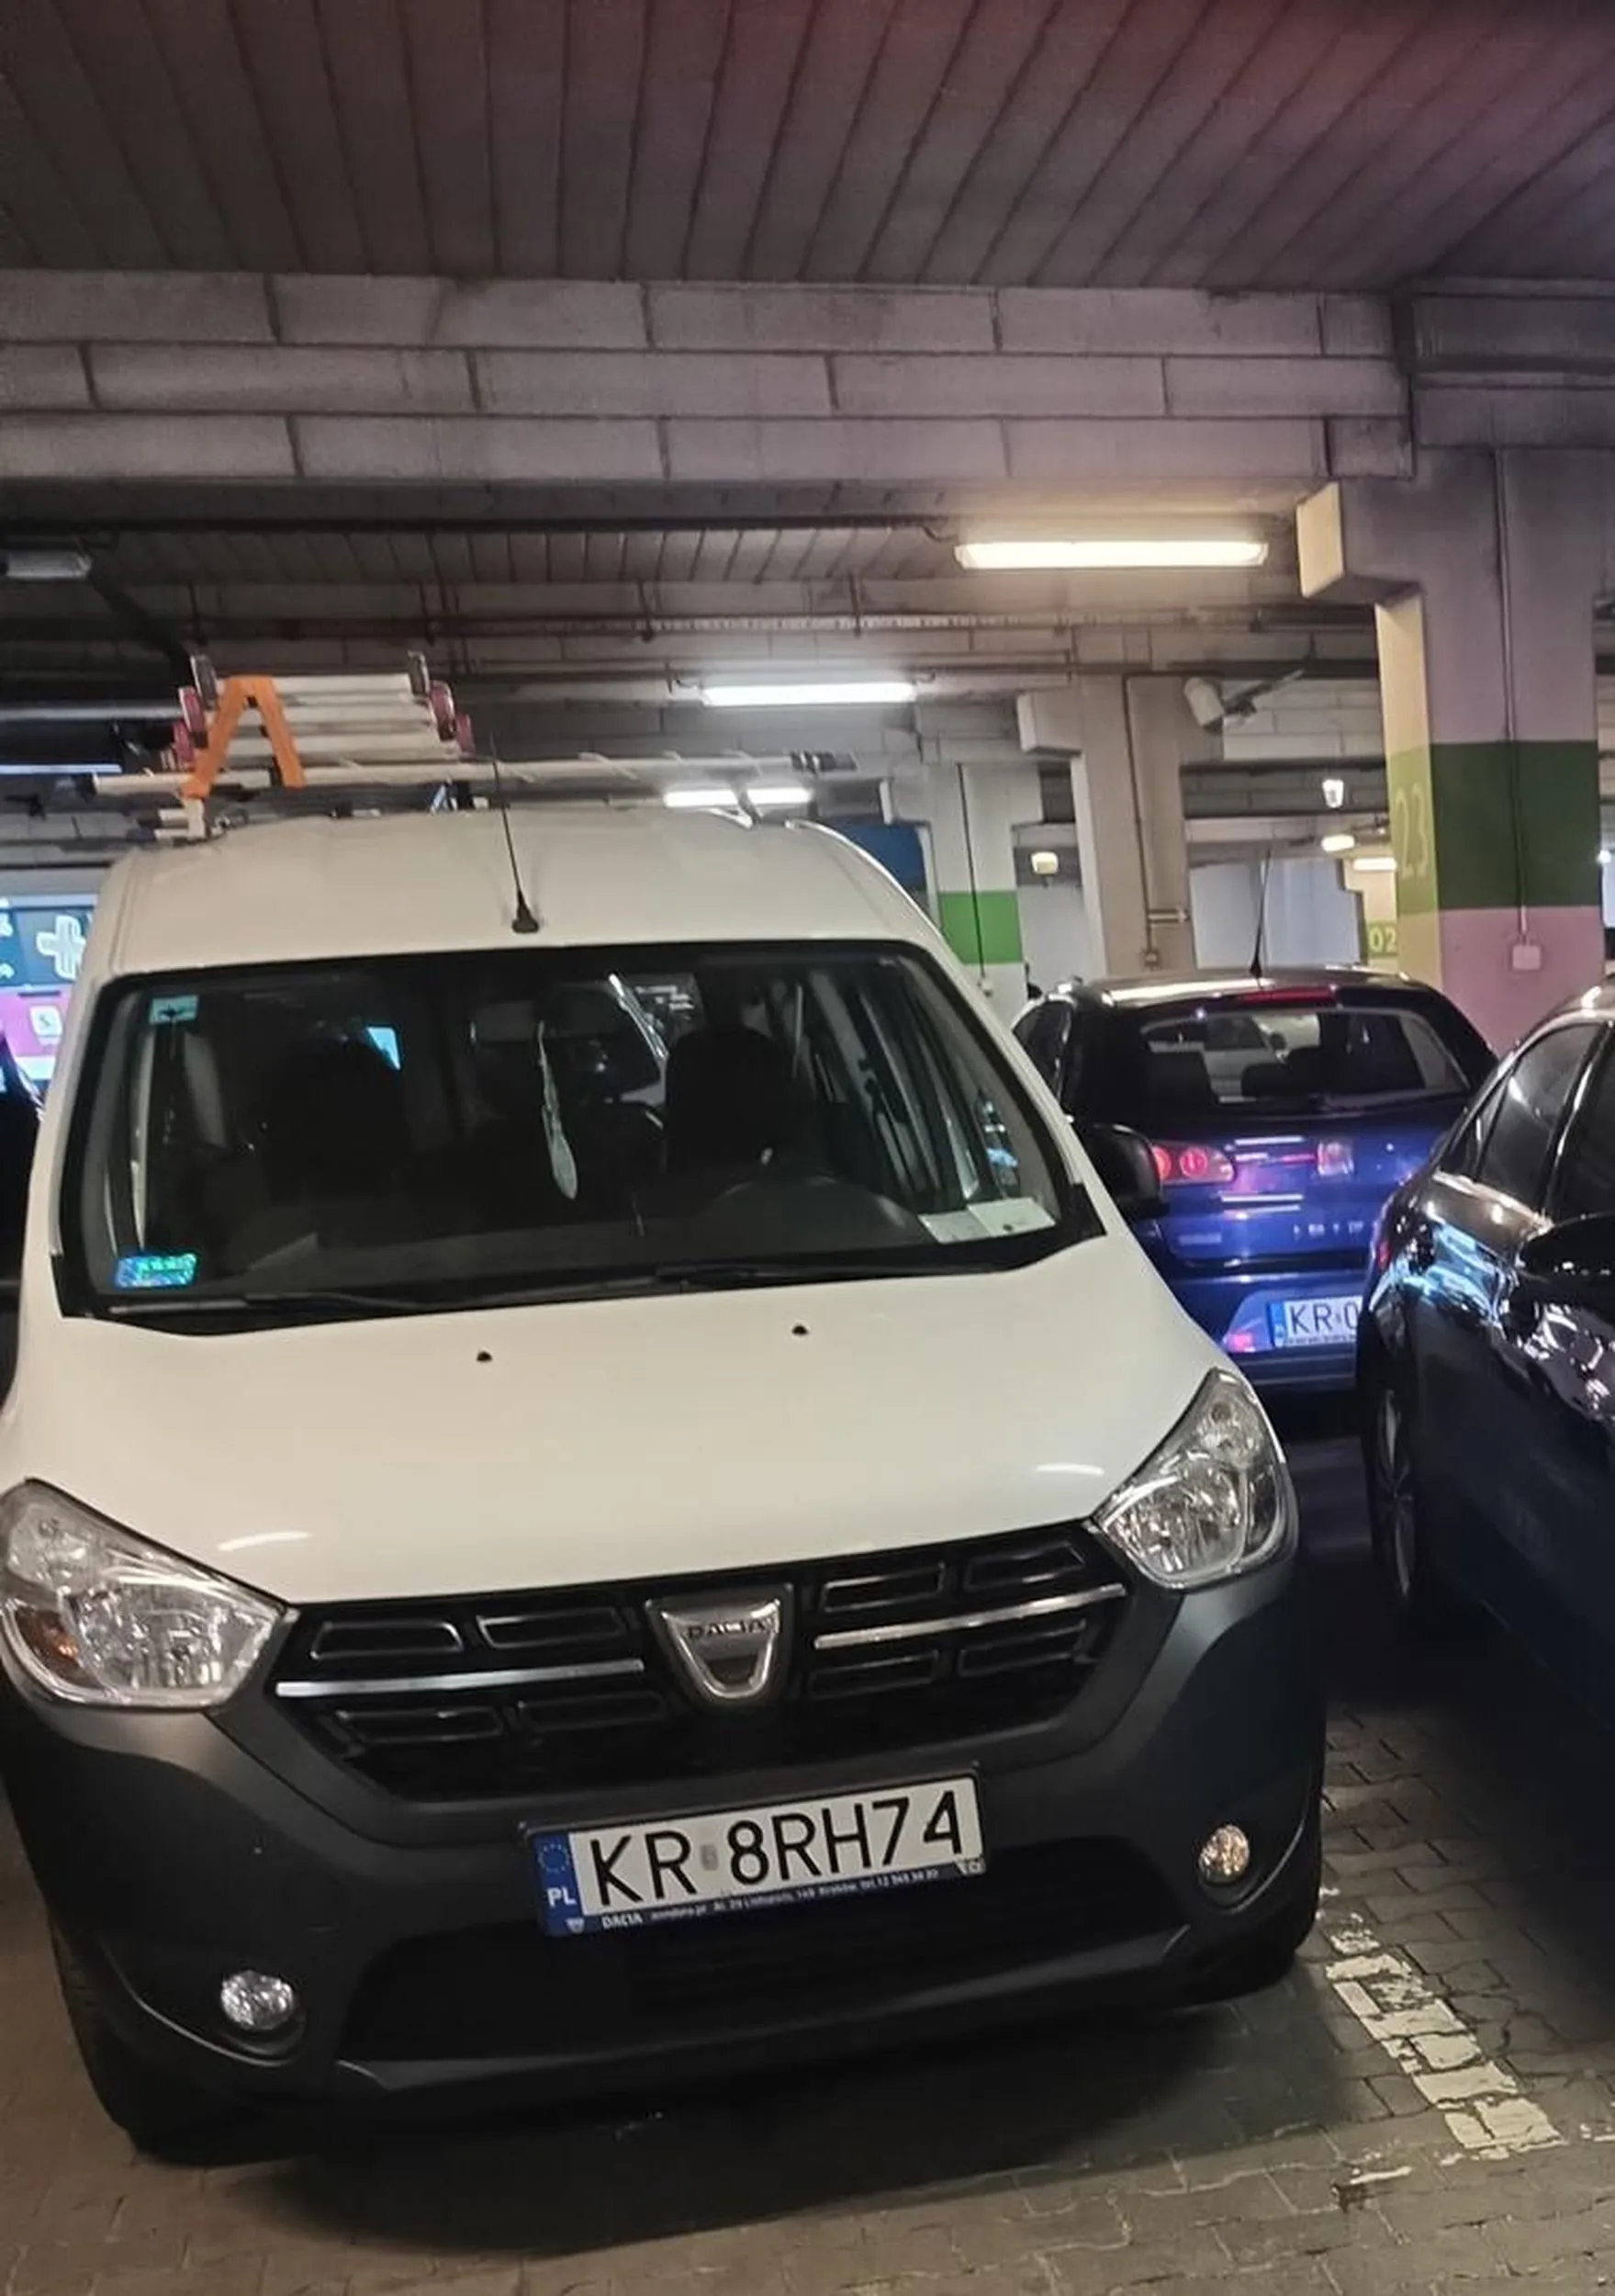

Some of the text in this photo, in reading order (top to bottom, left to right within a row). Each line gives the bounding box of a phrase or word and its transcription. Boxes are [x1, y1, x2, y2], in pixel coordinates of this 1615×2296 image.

[1368, 927, 1397, 951] 02
[1289, 1302, 1333, 1334] KR
[589, 1790, 963, 1907] KR 8RH74
[547, 1886, 577, 1908] PL
